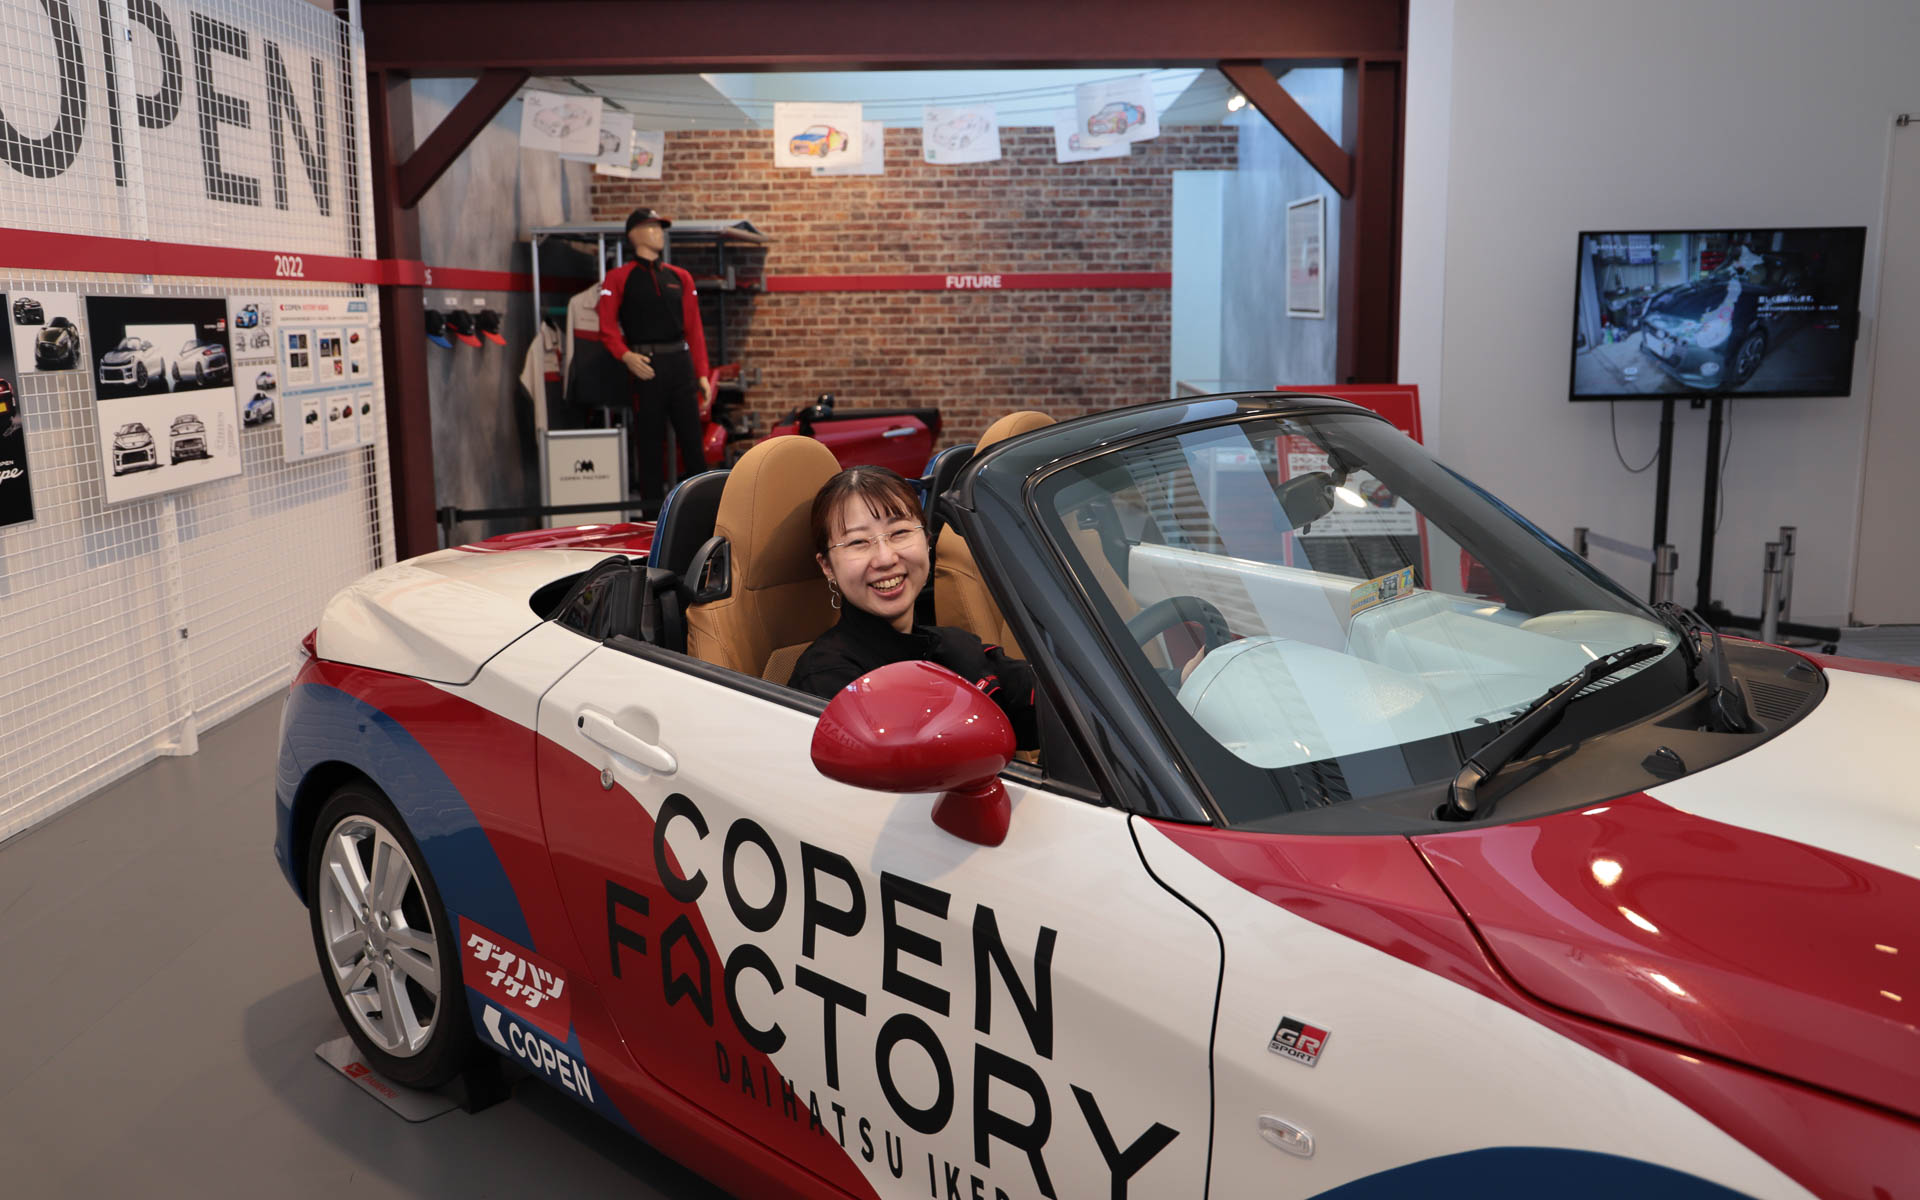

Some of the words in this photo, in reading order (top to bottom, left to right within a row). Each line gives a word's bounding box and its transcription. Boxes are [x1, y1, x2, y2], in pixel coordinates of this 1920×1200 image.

[274, 254, 304, 277] 2022
[946, 275, 1002, 289] FUTURE
[653, 792, 1058, 1060] COPEN
[466, 933, 565, 1000] ダイハツ
[485, 970, 549, 1009] イケダ
[508, 1021, 595, 1104] COPEN
[605, 879, 1180, 1200] FACTORY
[1271, 1041, 1314, 1062] SPORT
[1275, 1027, 1320, 1055] GR
[715, 1040, 903, 1179] DAIHATSU
